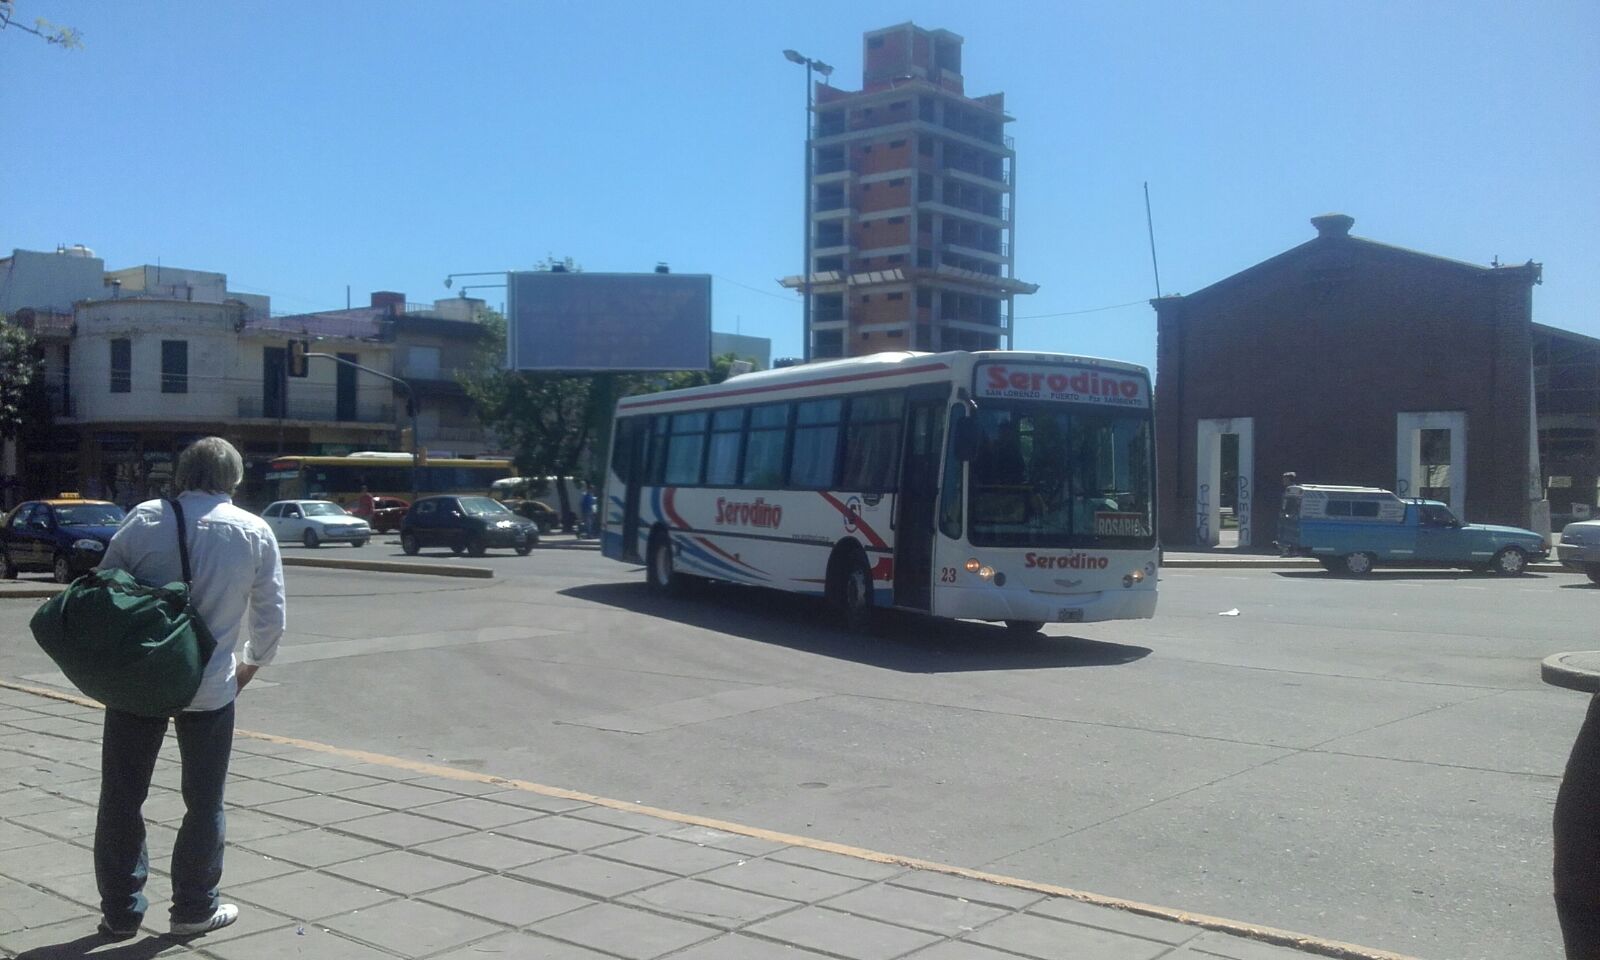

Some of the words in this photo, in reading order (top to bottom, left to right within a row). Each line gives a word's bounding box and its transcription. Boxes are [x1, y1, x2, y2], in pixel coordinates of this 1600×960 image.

[987, 366, 1138, 399] Serodino
[1003, 391, 1040, 399] LORENZO
[1050, 393, 1080, 401] PUERTO
[715, 496, 783, 529] Serodino
[1098, 519, 1140, 536] ROSARIO
[1024, 552, 1109, 570] Serodino
[941, 567, 957, 583] 23
